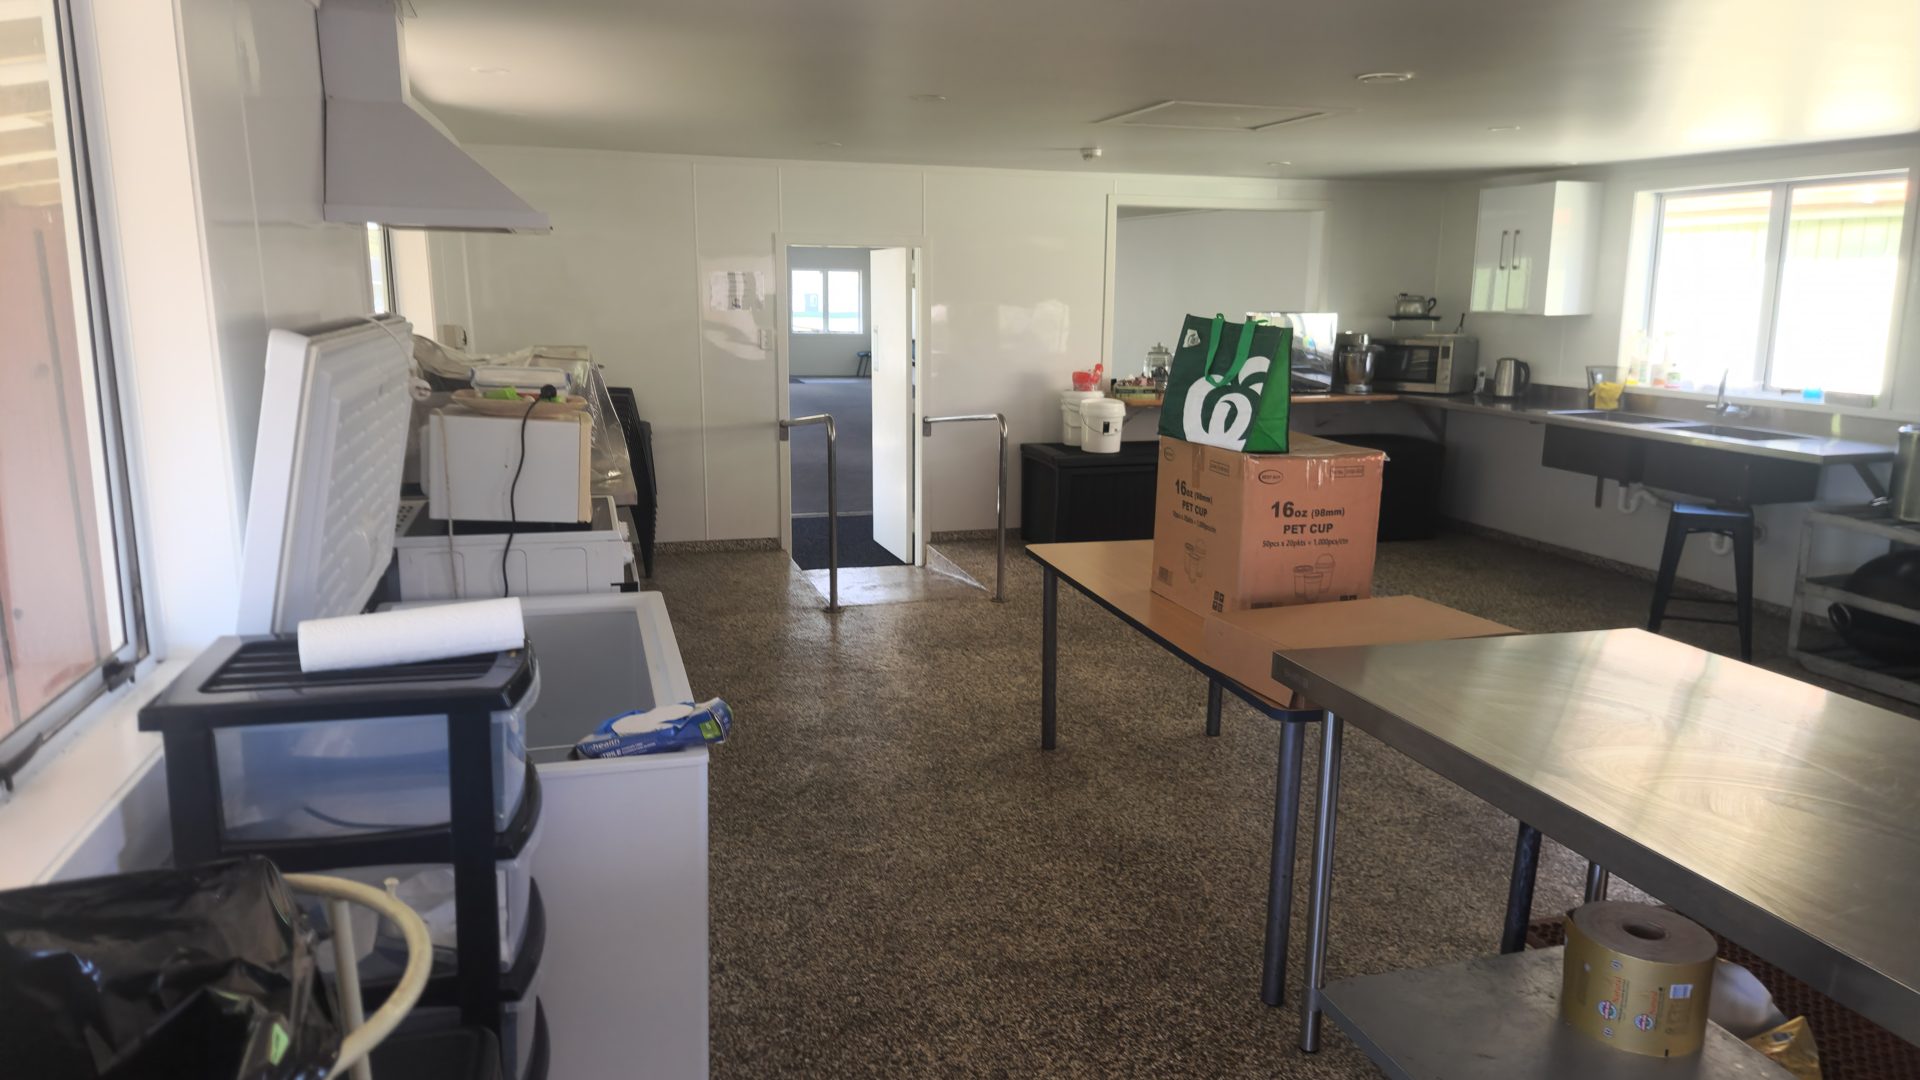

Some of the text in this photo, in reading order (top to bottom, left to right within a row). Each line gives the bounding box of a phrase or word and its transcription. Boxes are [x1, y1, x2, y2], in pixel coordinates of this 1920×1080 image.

[1175, 479, 1193, 497] 16oz
[1182, 500, 1208, 518] PET CUP
[1271, 501, 1345, 519] 16oz (98mm)
[1283, 523, 1334, 534] PET CUP
